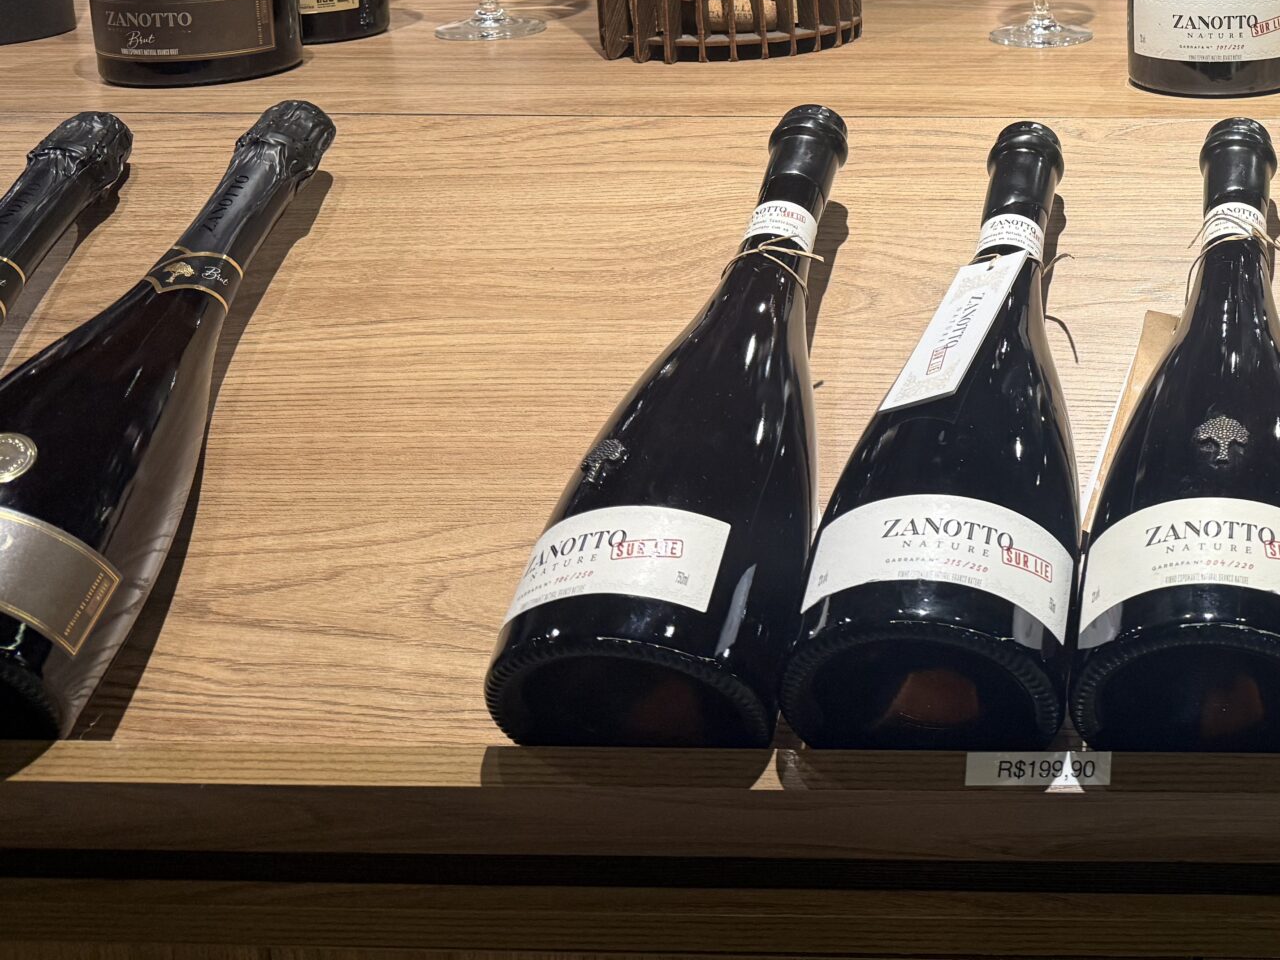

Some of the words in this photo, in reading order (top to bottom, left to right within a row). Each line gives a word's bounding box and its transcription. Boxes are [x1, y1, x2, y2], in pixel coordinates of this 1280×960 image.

[105, 10, 193, 28] ZANOTTO
[1172, 14, 1258, 30] ZANOTTO
[1254, 23, 1271, 35] SUR
[126, 30, 155, 49] Brut
[990, 218, 1037, 235] ZANOTTO
[201, 266, 229, 286] Brut
[945, 291, 985, 349] ZANOTTO
[881, 517, 1014, 550] ZANOTTO
[1144, 519, 1276, 547] ZANOTTO
[524, 529, 628, 578] ZANOTTO
[616, 542, 646, 558] SUR
[902, 540, 990, 558] NATURE
[1165, 542, 1253, 554] NATURE
[529, 553, 598, 582] NATURE
[1006, 548, 1029, 569] SUR
[1034, 559, 1050, 578] LIE
[1152, 560, 1190, 571] GARRAFA
[1206, 559, 1255, 570] 004/220
[997, 759, 1096, 781] R$199,90
